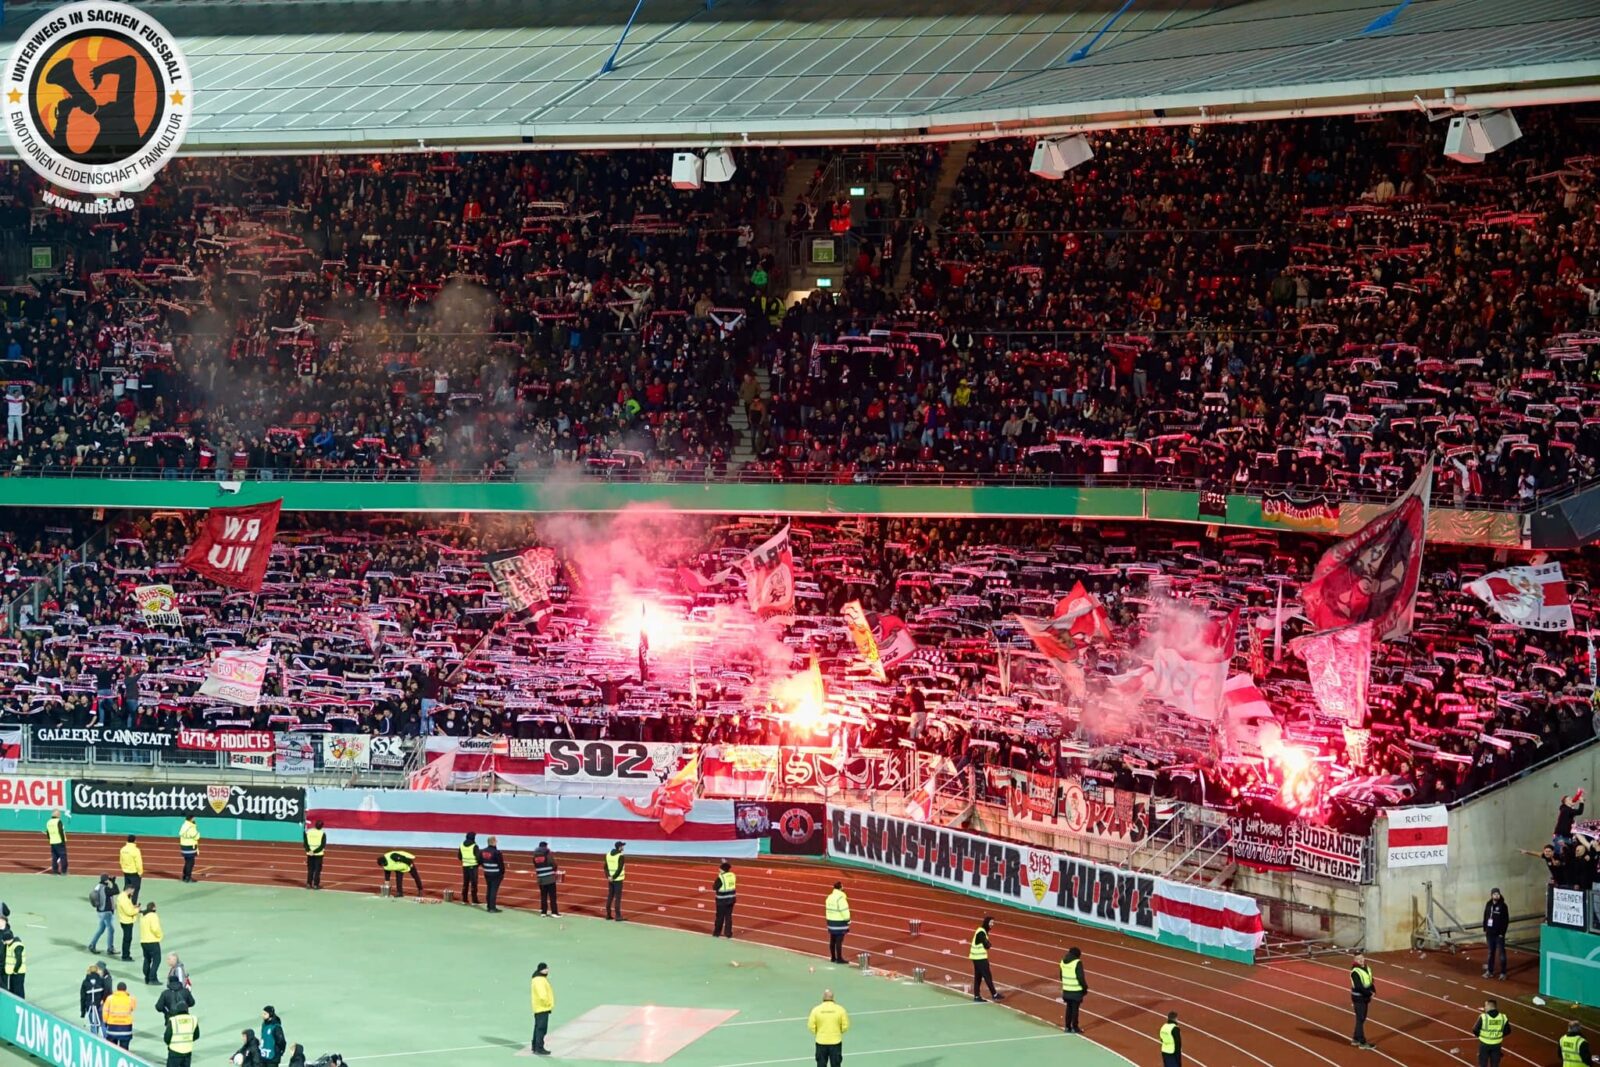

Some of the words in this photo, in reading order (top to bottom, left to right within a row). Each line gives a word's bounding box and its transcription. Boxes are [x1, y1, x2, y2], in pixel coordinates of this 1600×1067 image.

[103, 730, 171, 745] CANNSTATT
[181, 732, 205, 747] 0711
[221, 734, 270, 748] ADDICTS
[510, 739, 544, 750] ULTRAS
[0, 779, 63, 806] BACH
[74, 783, 207, 811] Cannstatter
[226, 785, 299, 820] Jungs
[1236, 840, 1289, 866] STUTTGART
[1293, 848, 1360, 880] STUTTGART
[1390, 850, 1444, 860] STUTTGART
[832, 809, 1021, 898] CANNSTATTER
[1057, 859, 1154, 928] KURVE
[15, 1005, 49, 1057] ZUM
[53, 1024, 76, 1067] 80.
